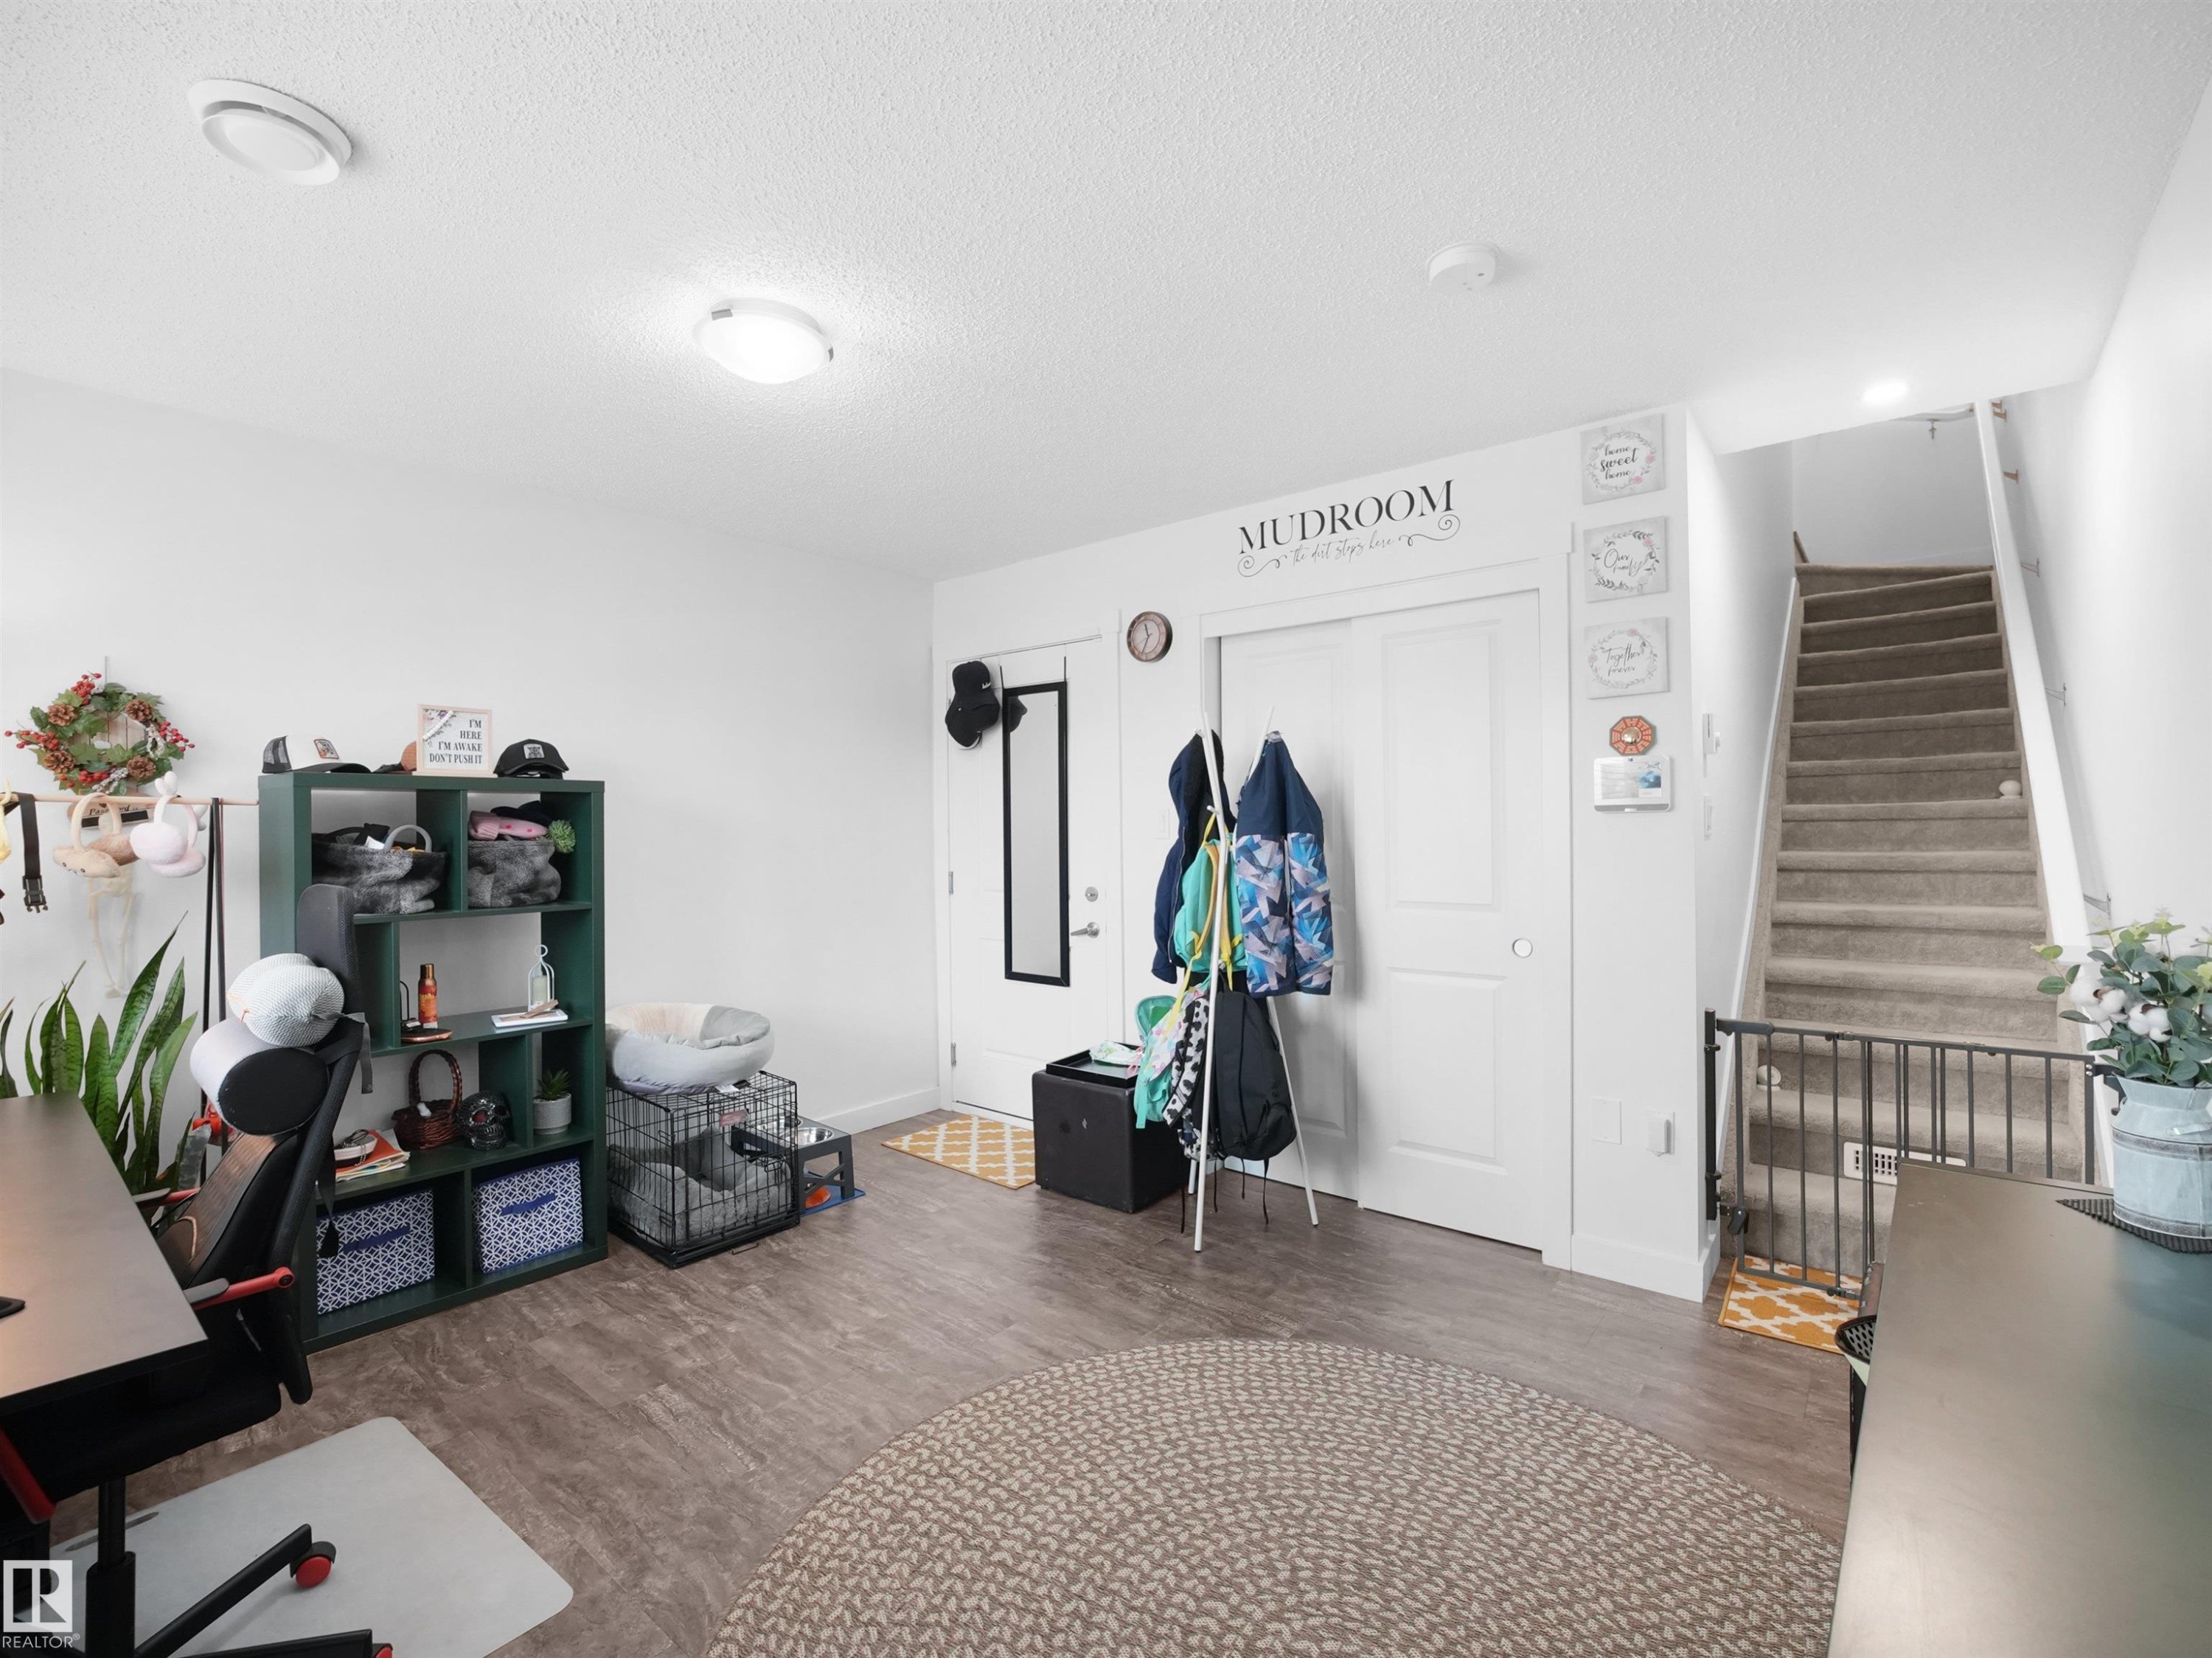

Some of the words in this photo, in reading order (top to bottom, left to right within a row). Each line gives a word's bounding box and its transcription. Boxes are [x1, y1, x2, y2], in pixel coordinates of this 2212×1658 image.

[1605, 444, 1631, 456] home
[1600, 447, 1639, 473] sweet
[1605, 468, 1632, 479] home
[1239, 479, 1454, 555] MUDROOM
[1290, 544, 1310, 566] the
[1312, 541, 1335, 563] dirt
[1335, 538, 1364, 563] stops
[1368, 530, 1394, 549] here
[1604, 548, 1630, 568] Our
[1602, 642, 1641, 667] Together
[470, 718, 481, 729] I'M
[459, 730, 482, 740] HERE
[438, 740, 451, 751] I'M
[453, 742, 483, 752] AWAKE
[429, 753, 452, 763] DON'T
[453, 754, 473, 764] PUSH
[474, 755, 483, 764] IT
